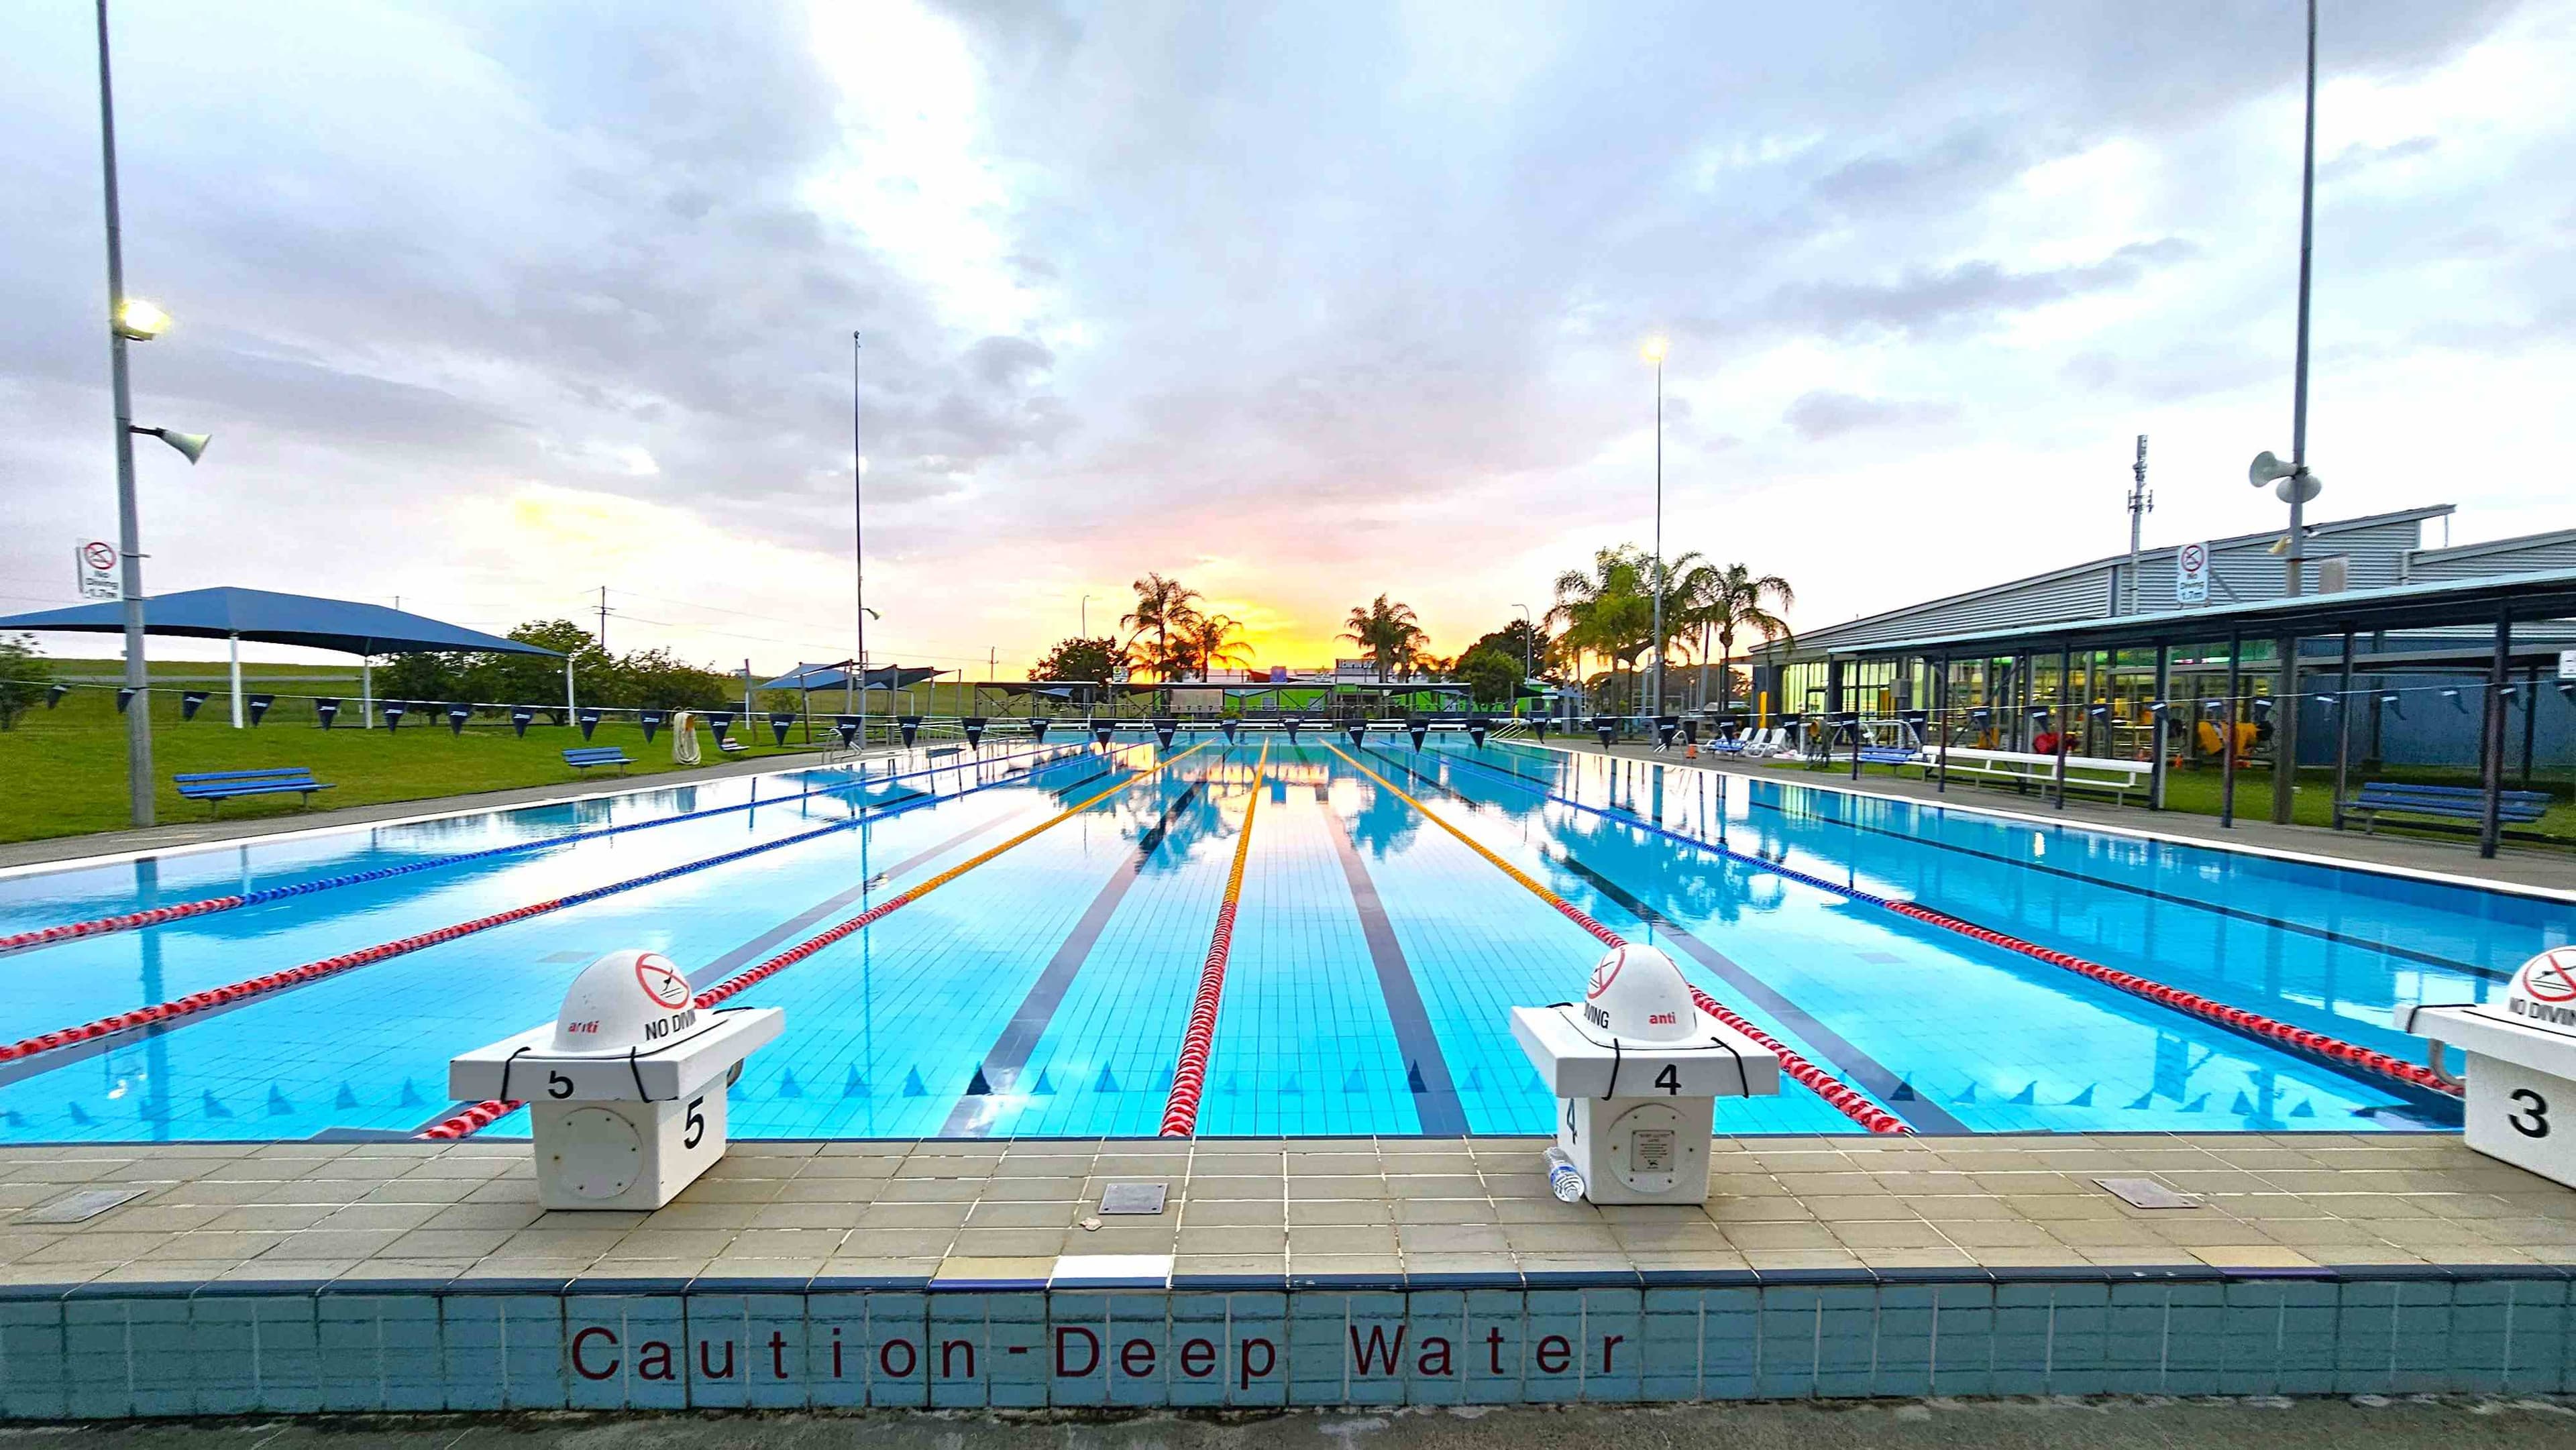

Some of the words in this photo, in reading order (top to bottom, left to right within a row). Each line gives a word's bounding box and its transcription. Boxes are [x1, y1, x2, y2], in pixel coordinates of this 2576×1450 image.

[86, 577, 119, 590] Diving
[2180, 581, 2204, 590] Diving
[645, 1018, 669, 1041] NO
[1648, 1011, 1677, 1025] anti
[547, 1070, 574, 1100] 5
[1654, 1064, 1682, 1096] 4
[683, 1095, 705, 1150] 5
[1566, 1097, 1578, 1146] 4
[2508, 1088, 2551, 1139] 3
[1350, 1325, 1625, 1377] Water
